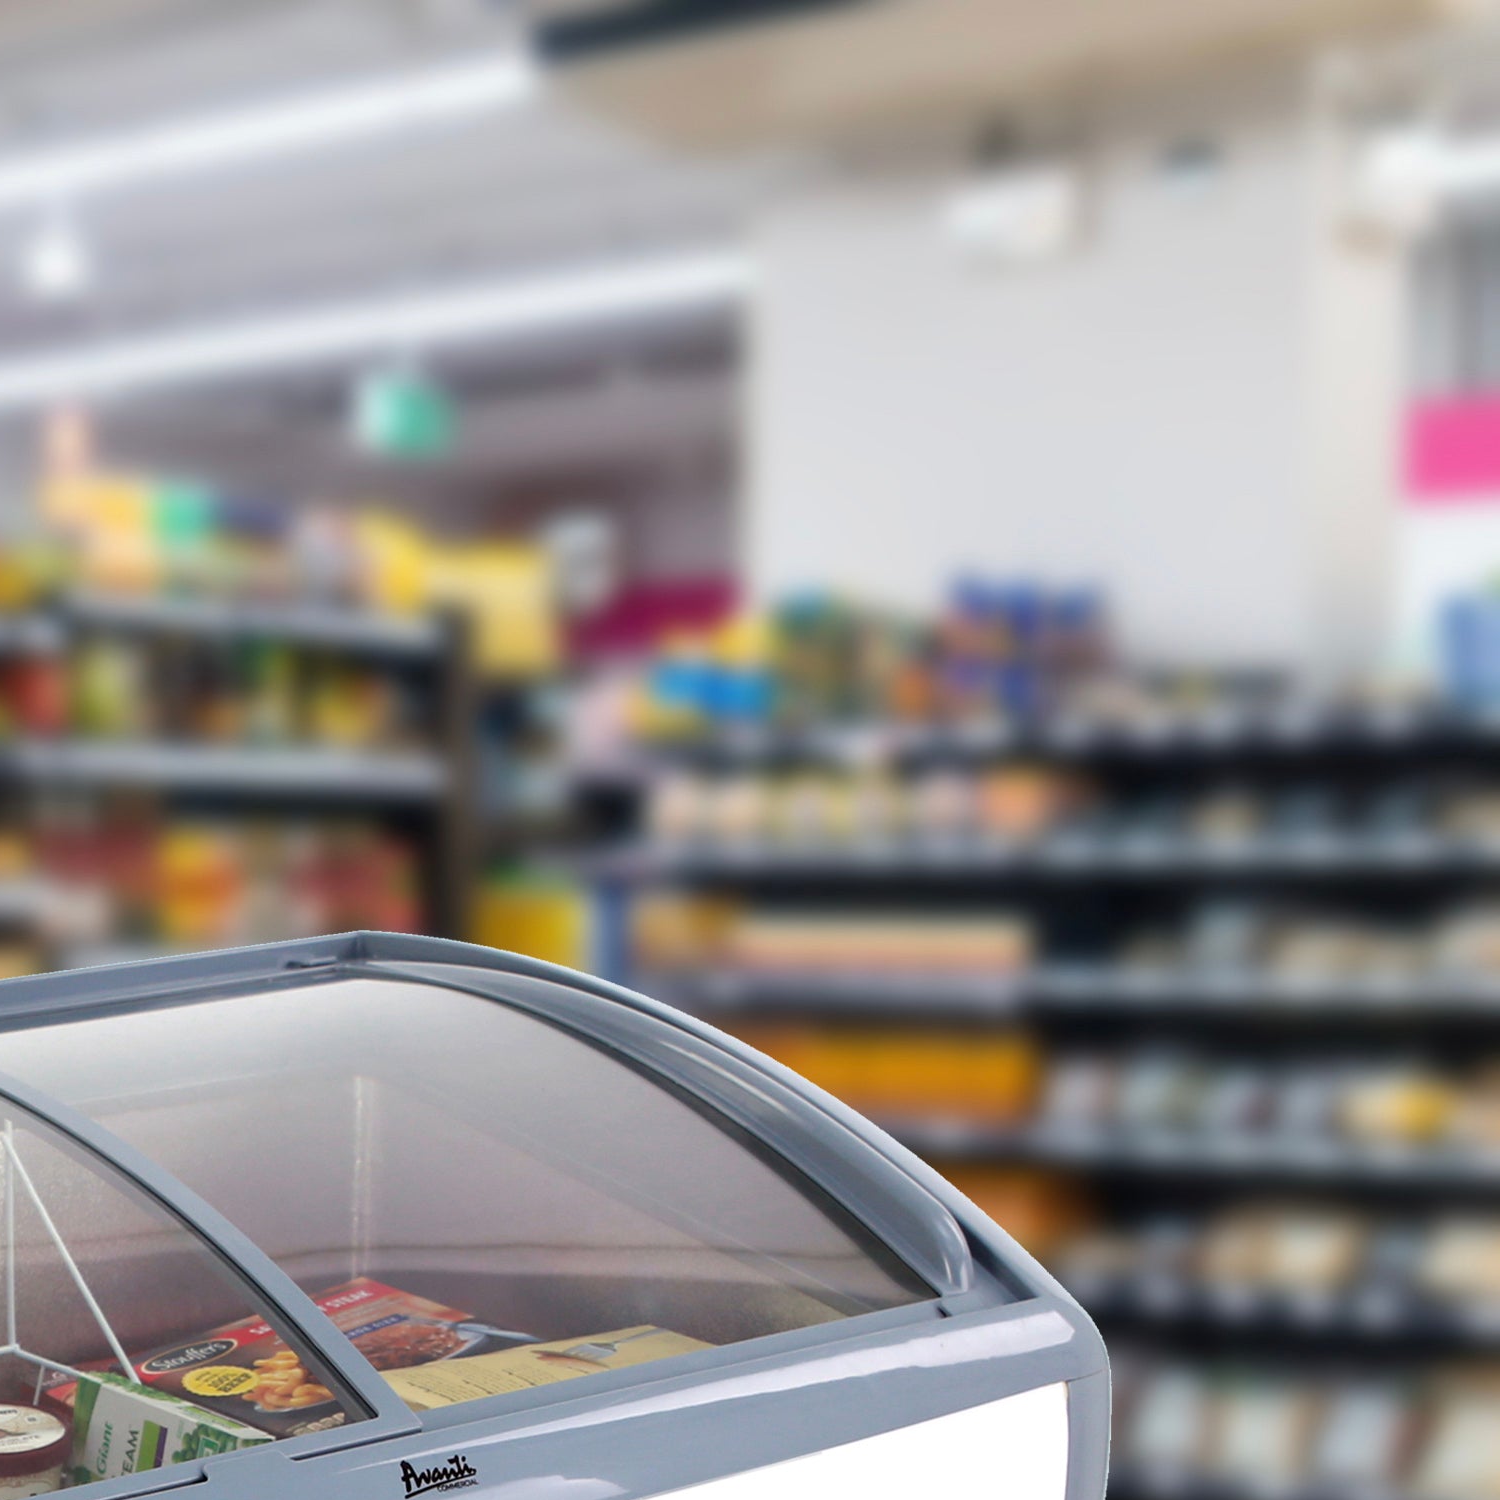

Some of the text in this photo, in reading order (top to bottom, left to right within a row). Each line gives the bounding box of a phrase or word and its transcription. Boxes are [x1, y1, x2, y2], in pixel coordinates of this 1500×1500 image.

[152, 1340, 228, 1371] Stouffer's
[96, 1421, 113, 1475] Giant
[400, 1454, 477, 1494] Avanti
[437, 1478, 480, 1493] COMMERCIAL
